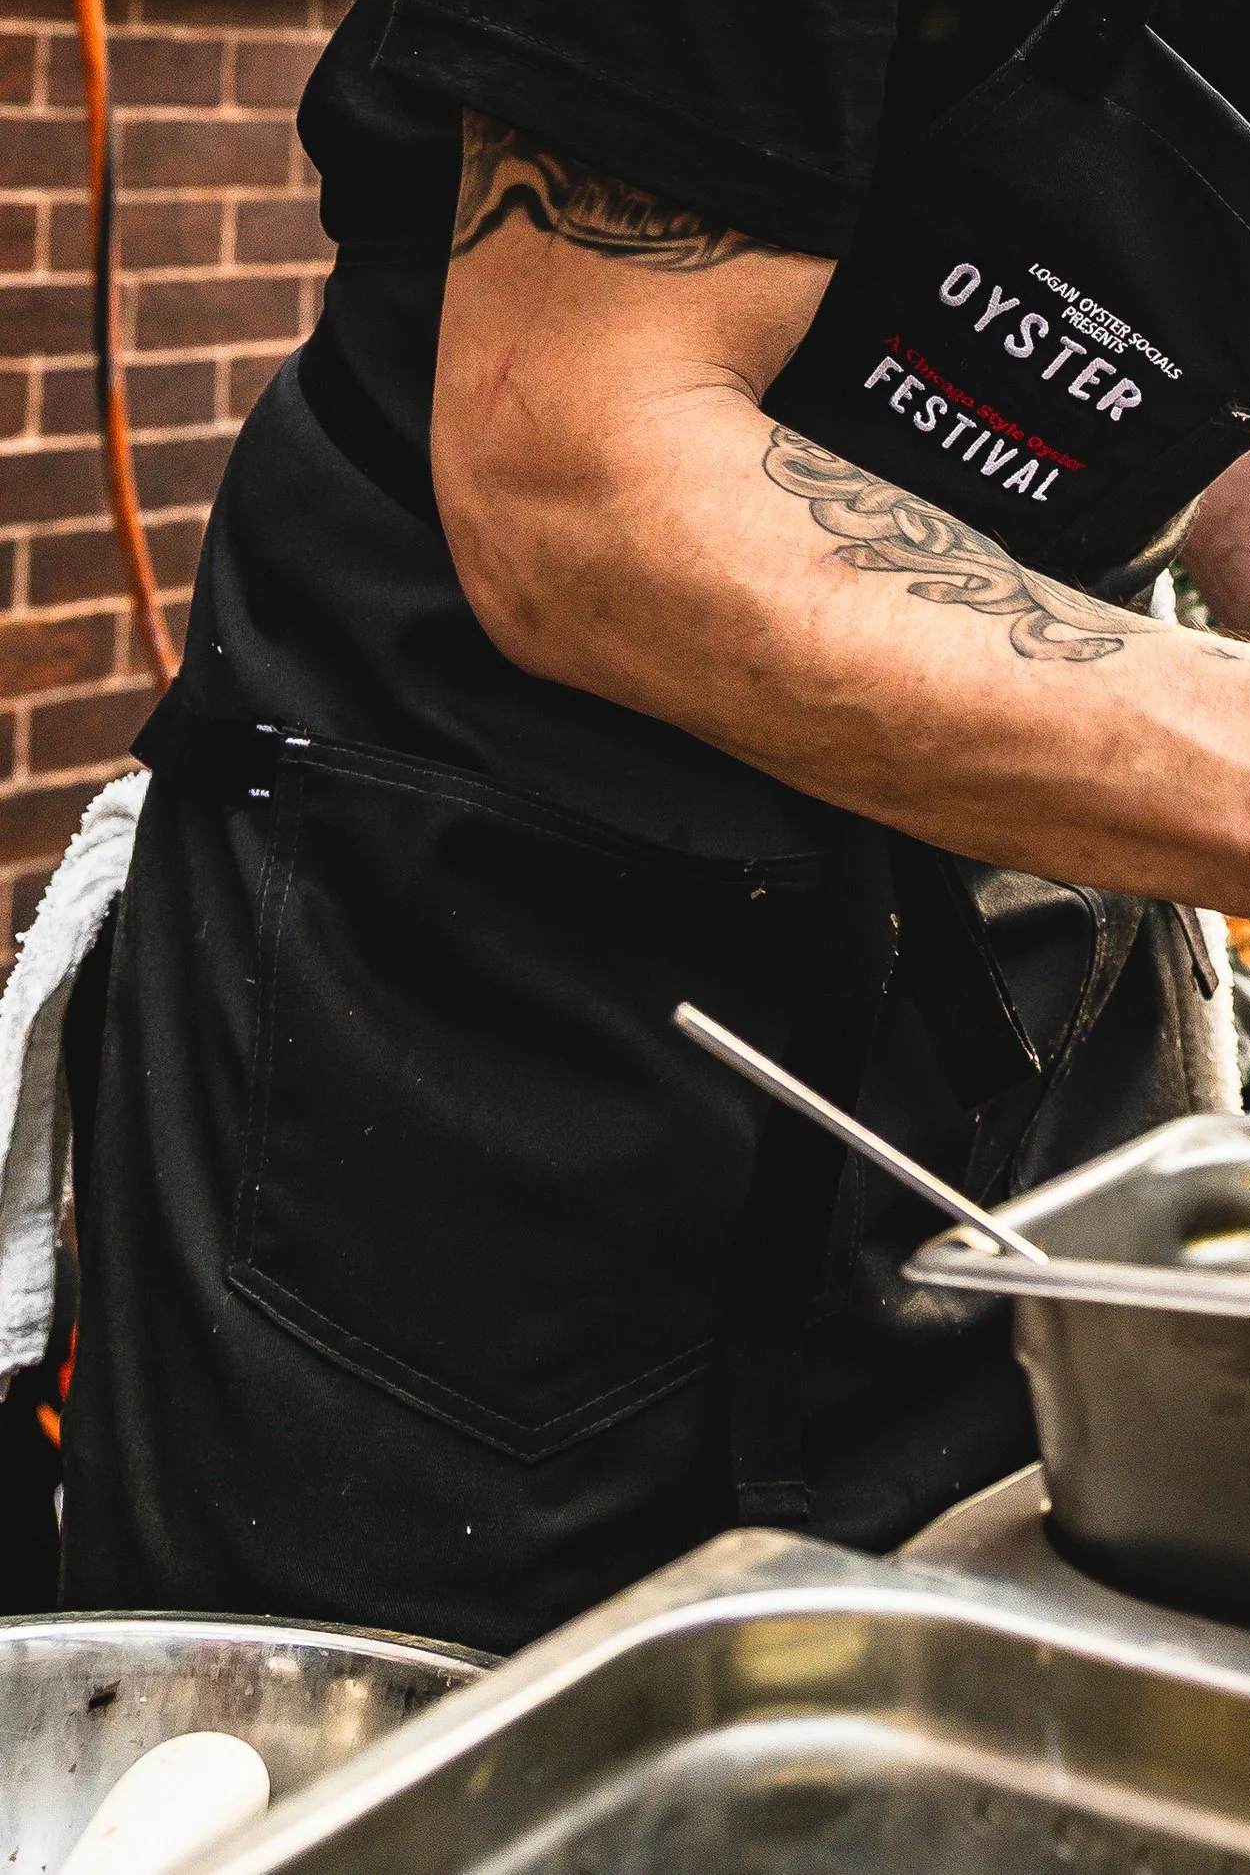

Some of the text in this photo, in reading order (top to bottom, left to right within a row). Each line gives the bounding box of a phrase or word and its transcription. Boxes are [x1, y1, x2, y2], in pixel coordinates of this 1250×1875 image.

[939, 262, 1142, 422] OYSTER
[1028, 263, 1183, 381] LOGAN OYSTER SOCIALS
[1061, 306, 1128, 355] PRESENTS
[864, 355, 1060, 502] FESTIVAL
[883, 335, 1086, 473] A Chicago Style Oyster
